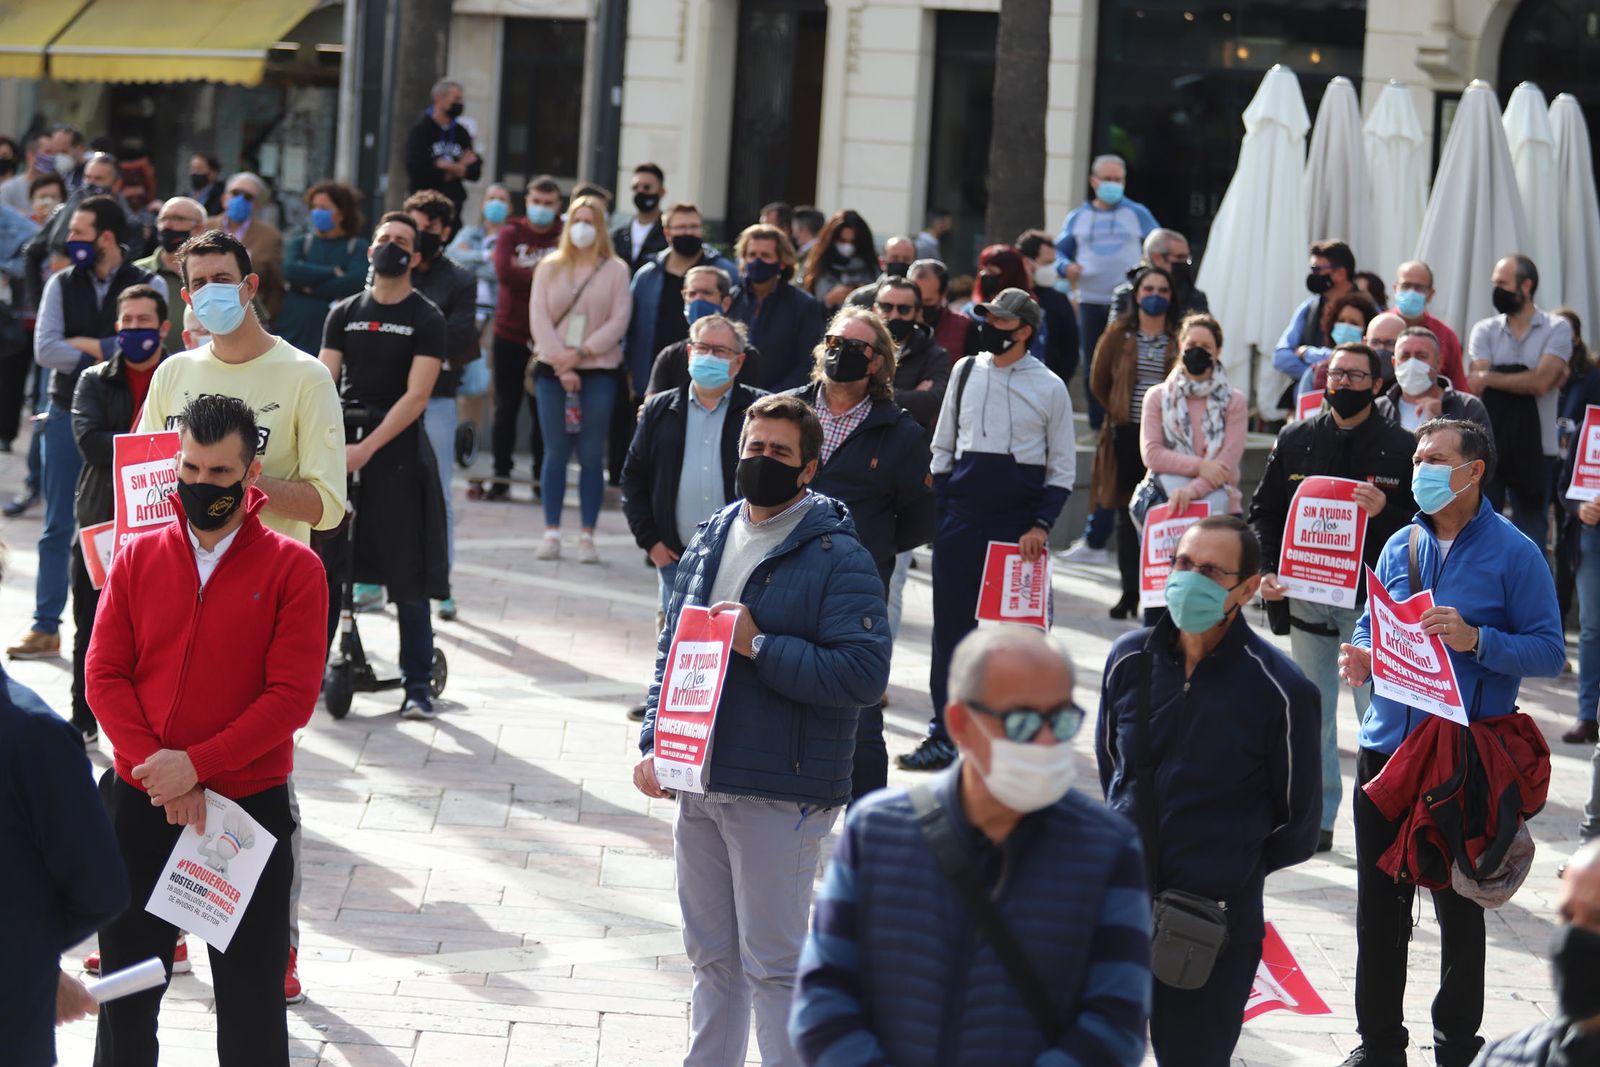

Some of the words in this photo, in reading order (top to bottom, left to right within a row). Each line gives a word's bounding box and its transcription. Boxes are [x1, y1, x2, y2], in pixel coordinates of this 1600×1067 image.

[131, 473, 147, 490] SIN
[150, 468, 176, 486] AYUD
[136, 500, 176, 522] Arruin
[1303, 505, 1317, 518] SIN
[1320, 507, 1352, 521] AYUDAS
[1311, 516, 1338, 533] Nos
[1301, 529, 1351, 547] Arruinan!
[1286, 548, 1357, 571] CONCENTRACIÓN
[1011, 560, 1023, 593] AYUDAS
[1378, 608, 1390, 626] SIN
[679, 653, 692, 670] SIN
[693, 653, 718, 670] AYUDAS
[1385, 631, 1434, 669] Arruinan!
[682, 667, 705, 691] Nos
[1375, 647, 1452, 691] CONCENTRACIÓN
[671, 687, 712, 706] Arruinan!
[657, 716, 709, 740] CONCENTRACIÓN
[176, 858, 241, 903] #YOQUIEROSER
[169, 871, 236, 916] HOSTELEROFRANCÉS
[168, 894, 176, 903] DE
[175, 898, 195, 912] AYUDAS
[194, 907, 200, 916] AL
[201, 911, 220, 926] SECTOR
[183, 892, 207, 908] MILLONES
[206, 904, 214, 912] DE
[213, 908, 229, 923] EUROS
